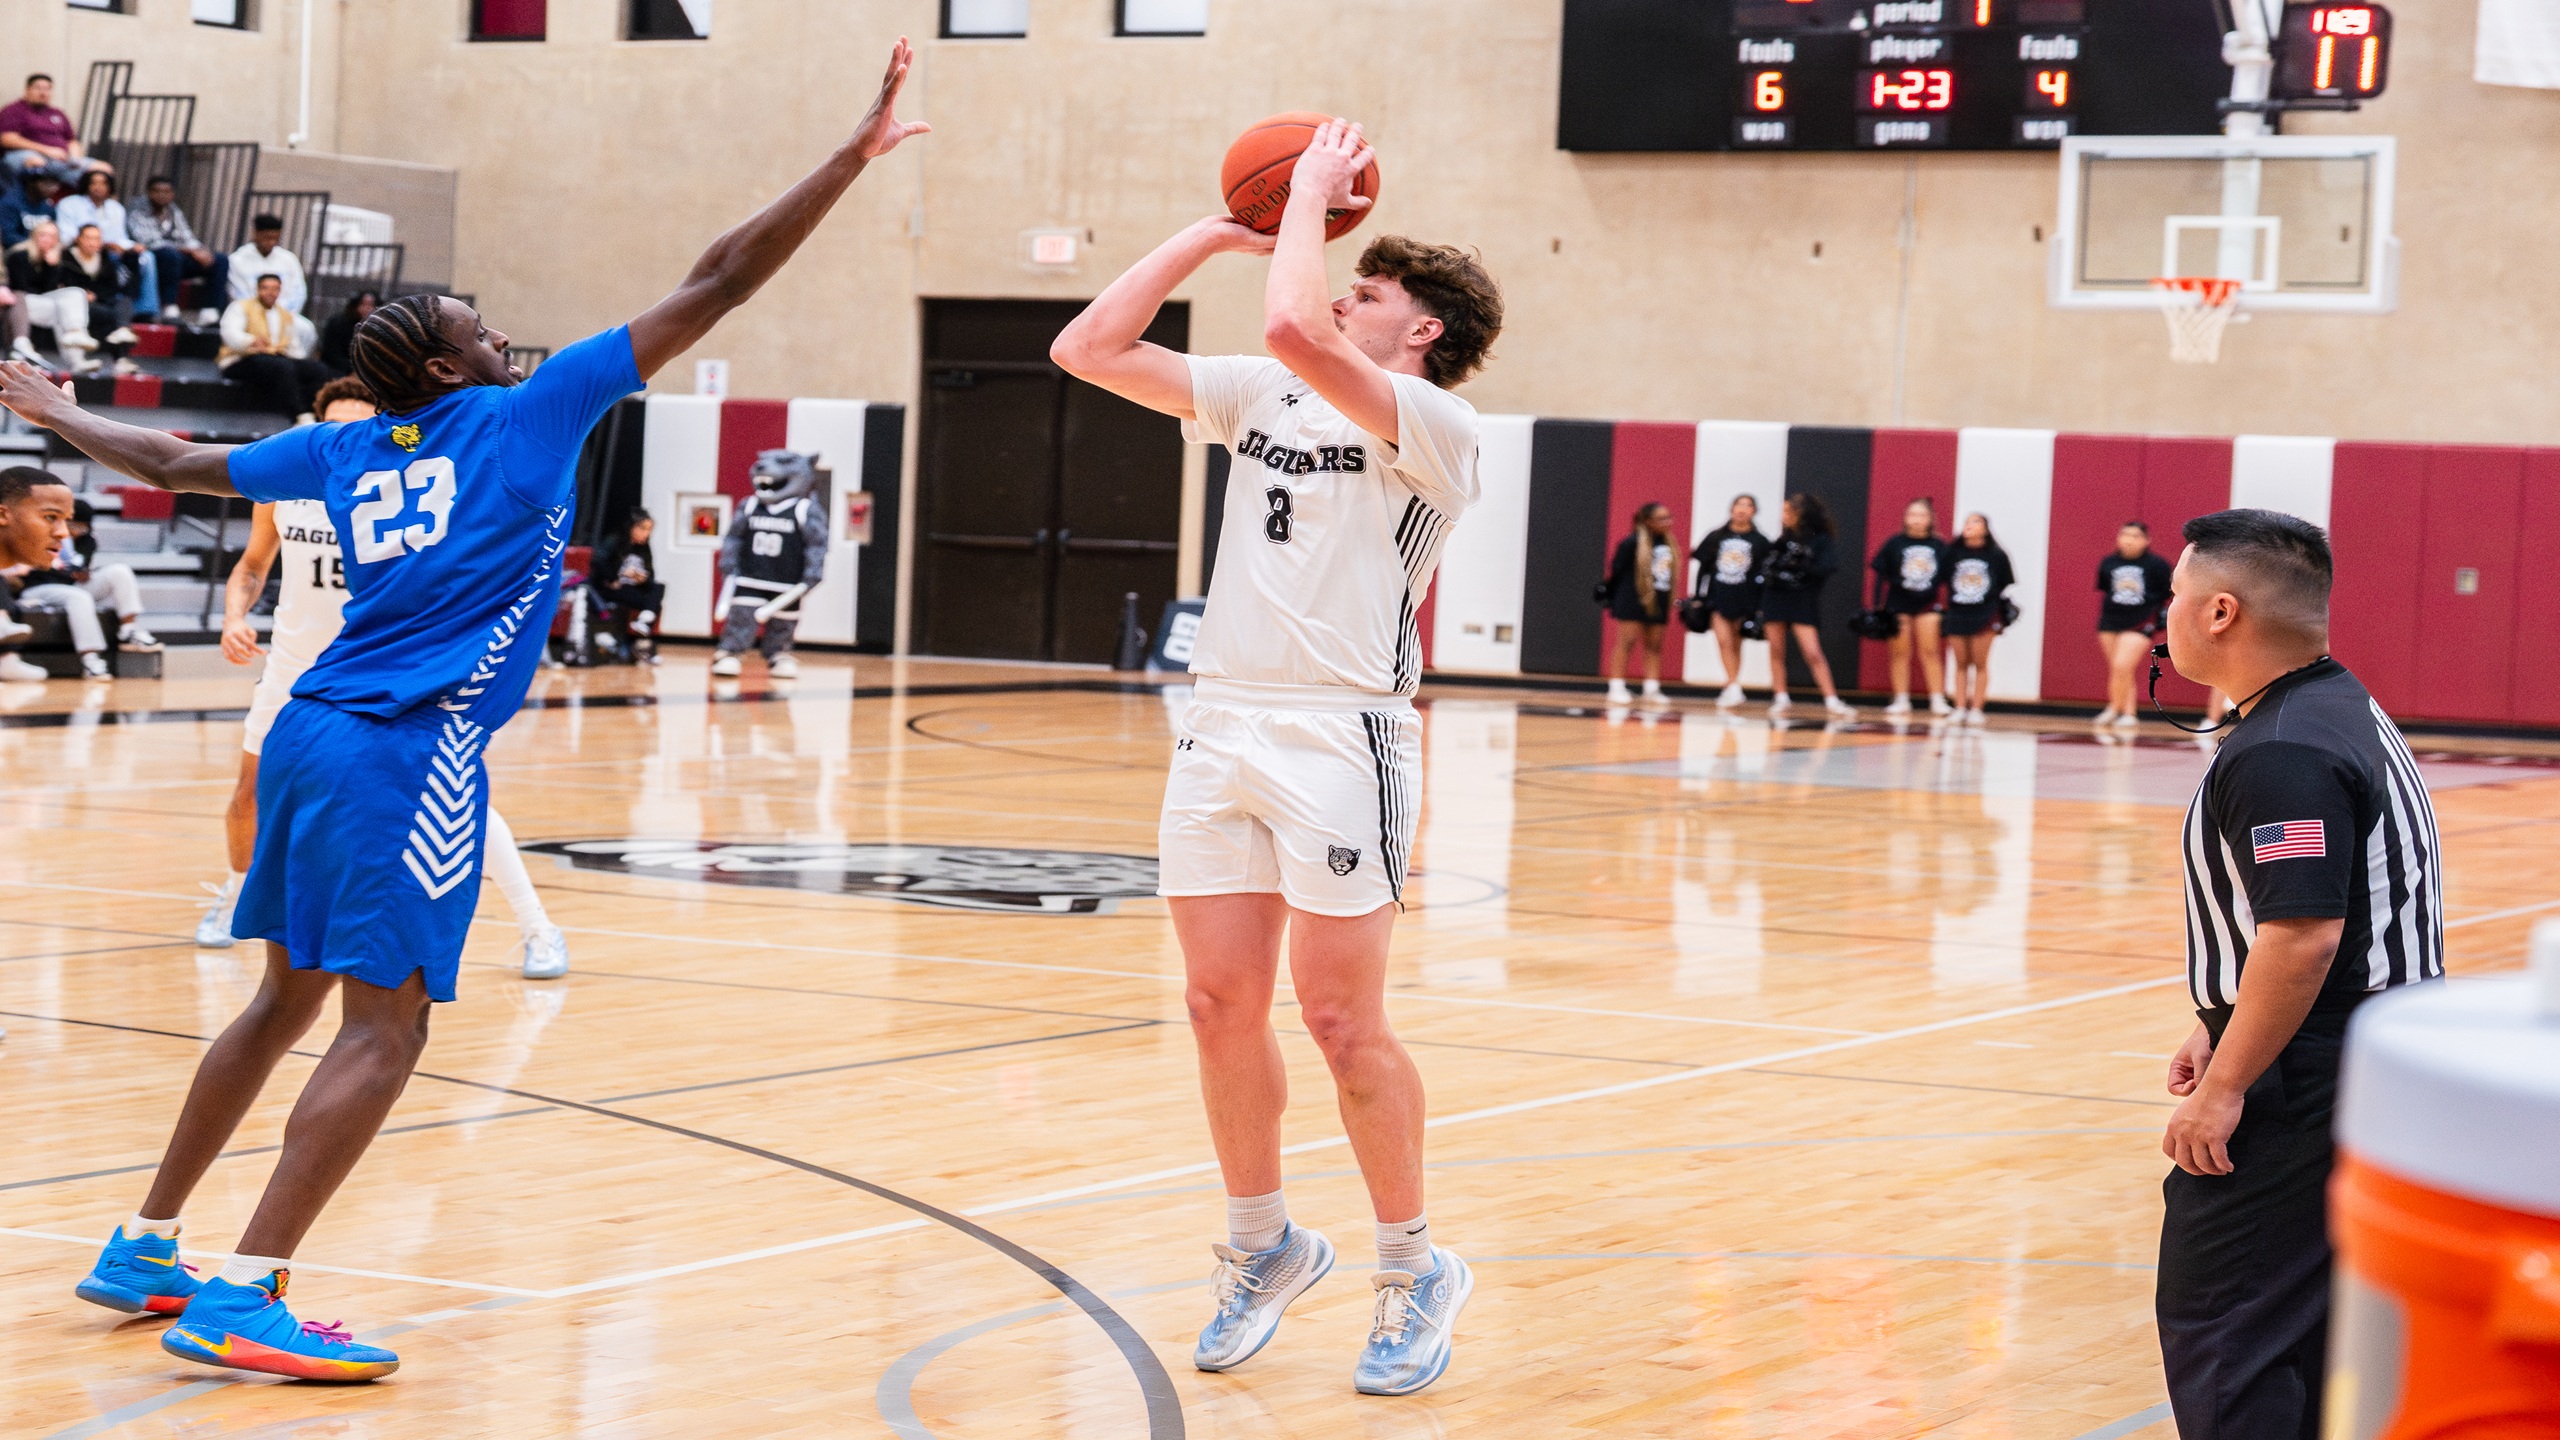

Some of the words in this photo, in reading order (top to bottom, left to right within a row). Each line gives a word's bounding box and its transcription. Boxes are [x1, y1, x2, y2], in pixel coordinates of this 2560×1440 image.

[1738, 38, 1795, 63] fouls
[1870, 35, 1943, 64] player
[2019, 34, 2079, 60] fouls
[1754, 71, 1785, 111] 6
[2036, 70, 2068, 107] 4
[1237, 427, 1367, 477] JAGUARS
[349, 455, 458, 565] 23
[1263, 484, 1294, 545] 8
[312, 555, 347, 590] 15
